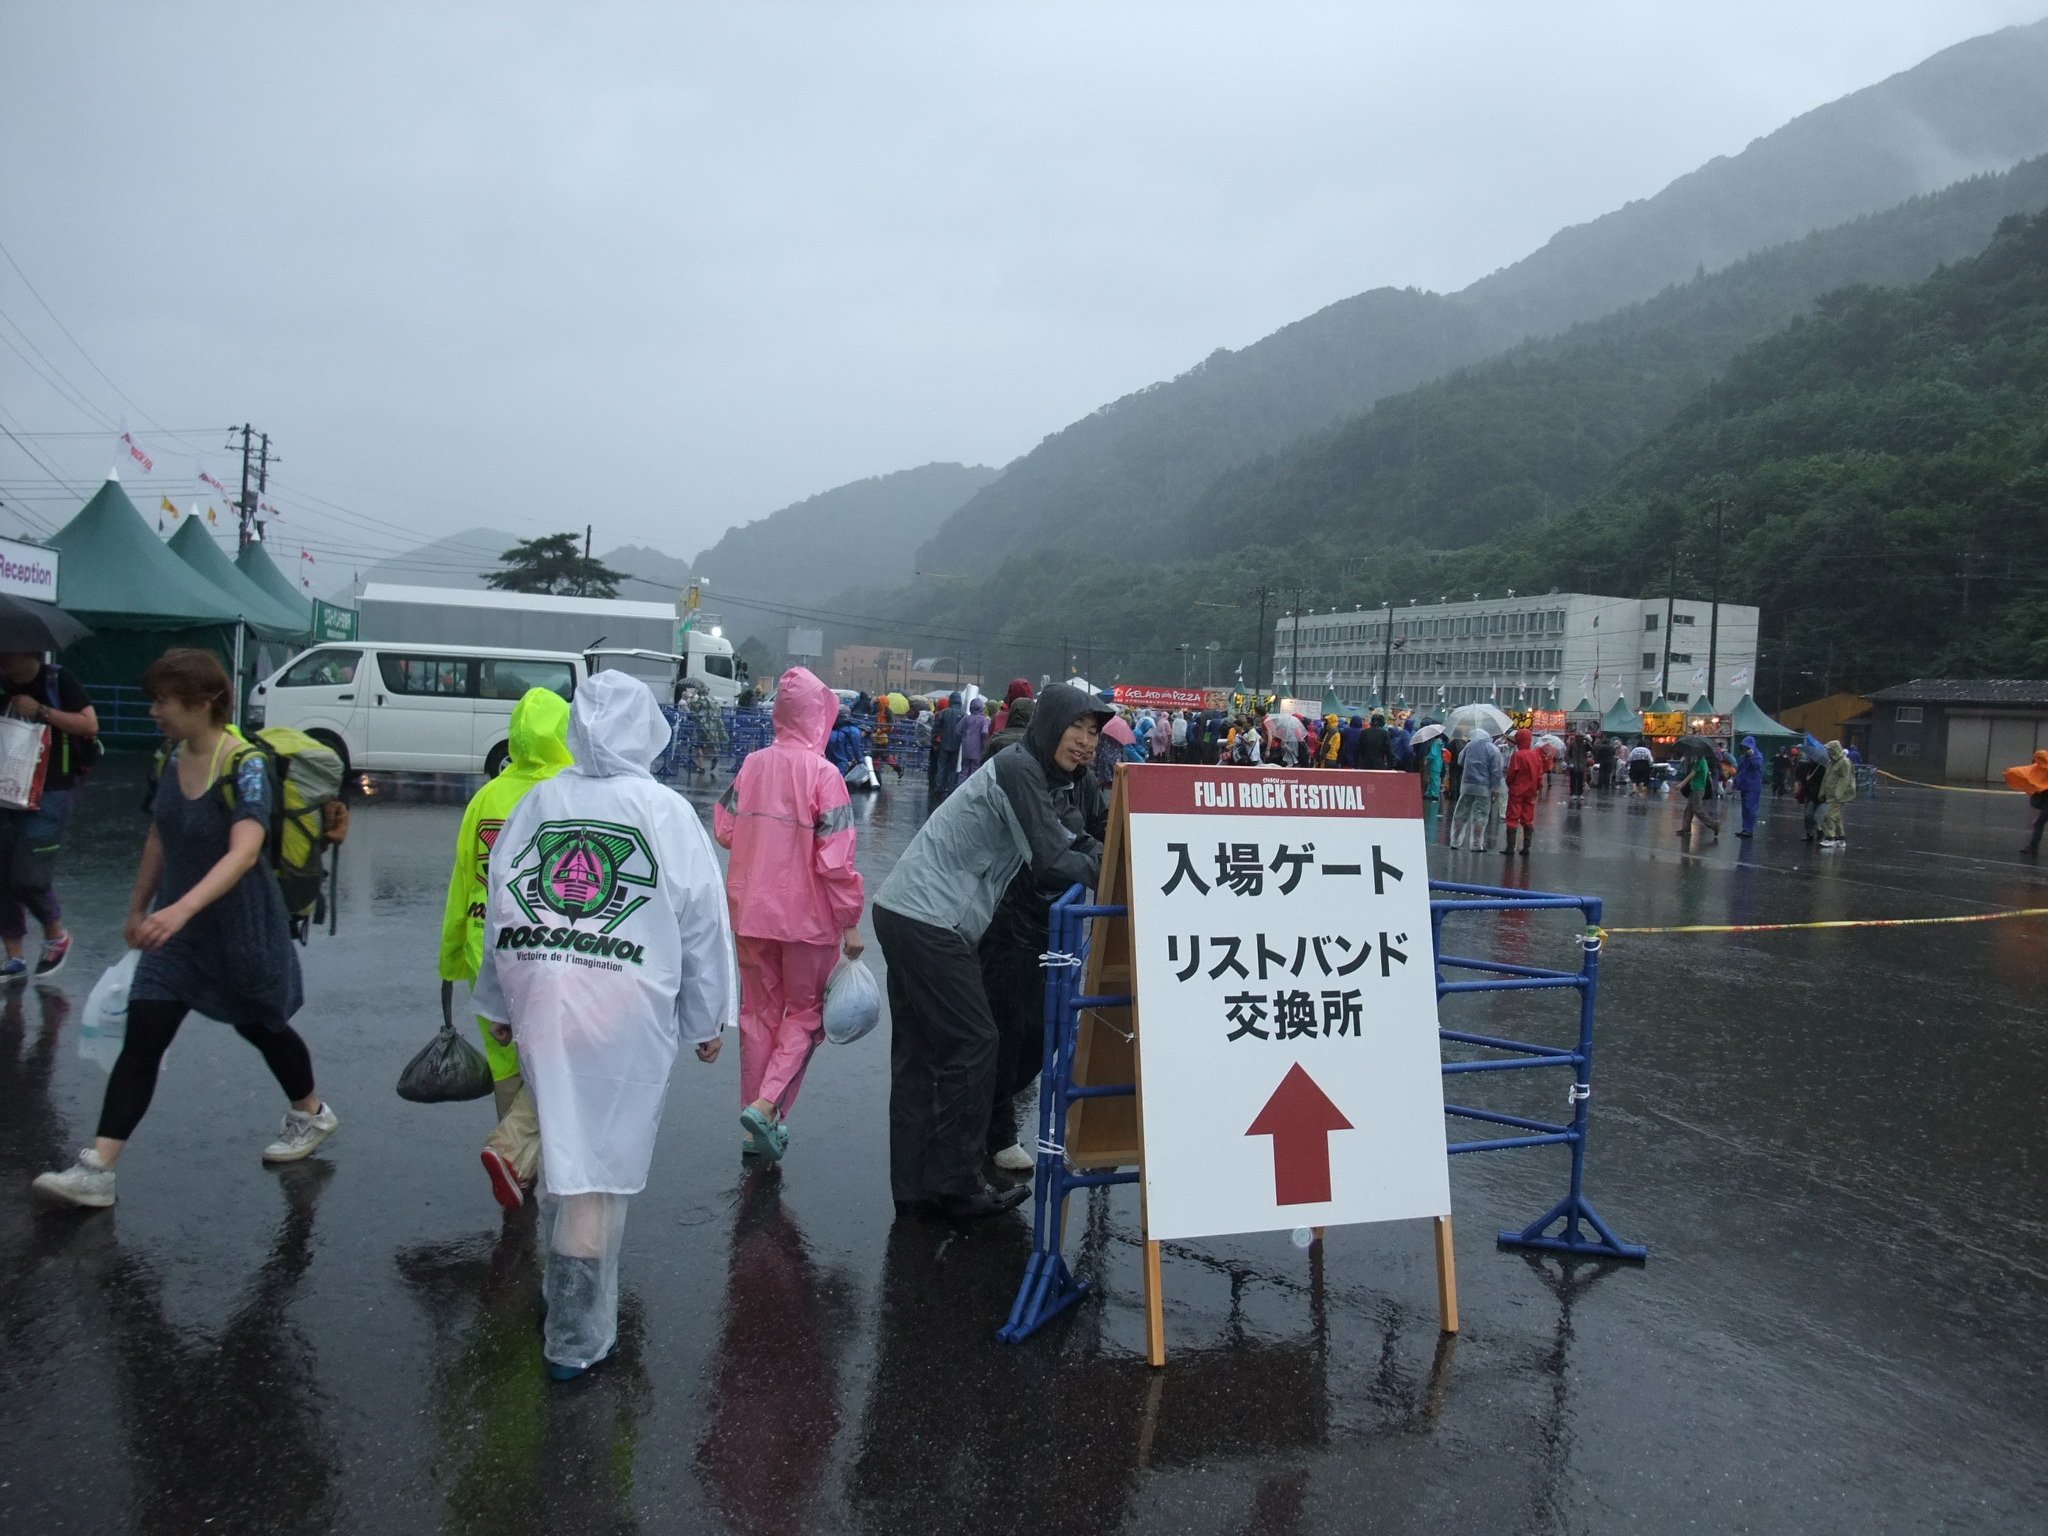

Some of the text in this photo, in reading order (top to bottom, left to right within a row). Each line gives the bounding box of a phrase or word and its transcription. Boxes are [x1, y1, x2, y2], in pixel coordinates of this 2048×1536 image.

[1125, 688, 1161, 699] GELATO
[1194, 781, 1366, 811] FUJI ROCK FESTIVAL
[1160, 841, 1405, 897] 入場ゲート
[496, 925, 645, 965] ROSSIGNOL
[516, 950, 623, 973] Victoire de l'imagination
[1167, 931, 1409, 983] リストバンド
[1224, 988, 1364, 1042] 交換所
